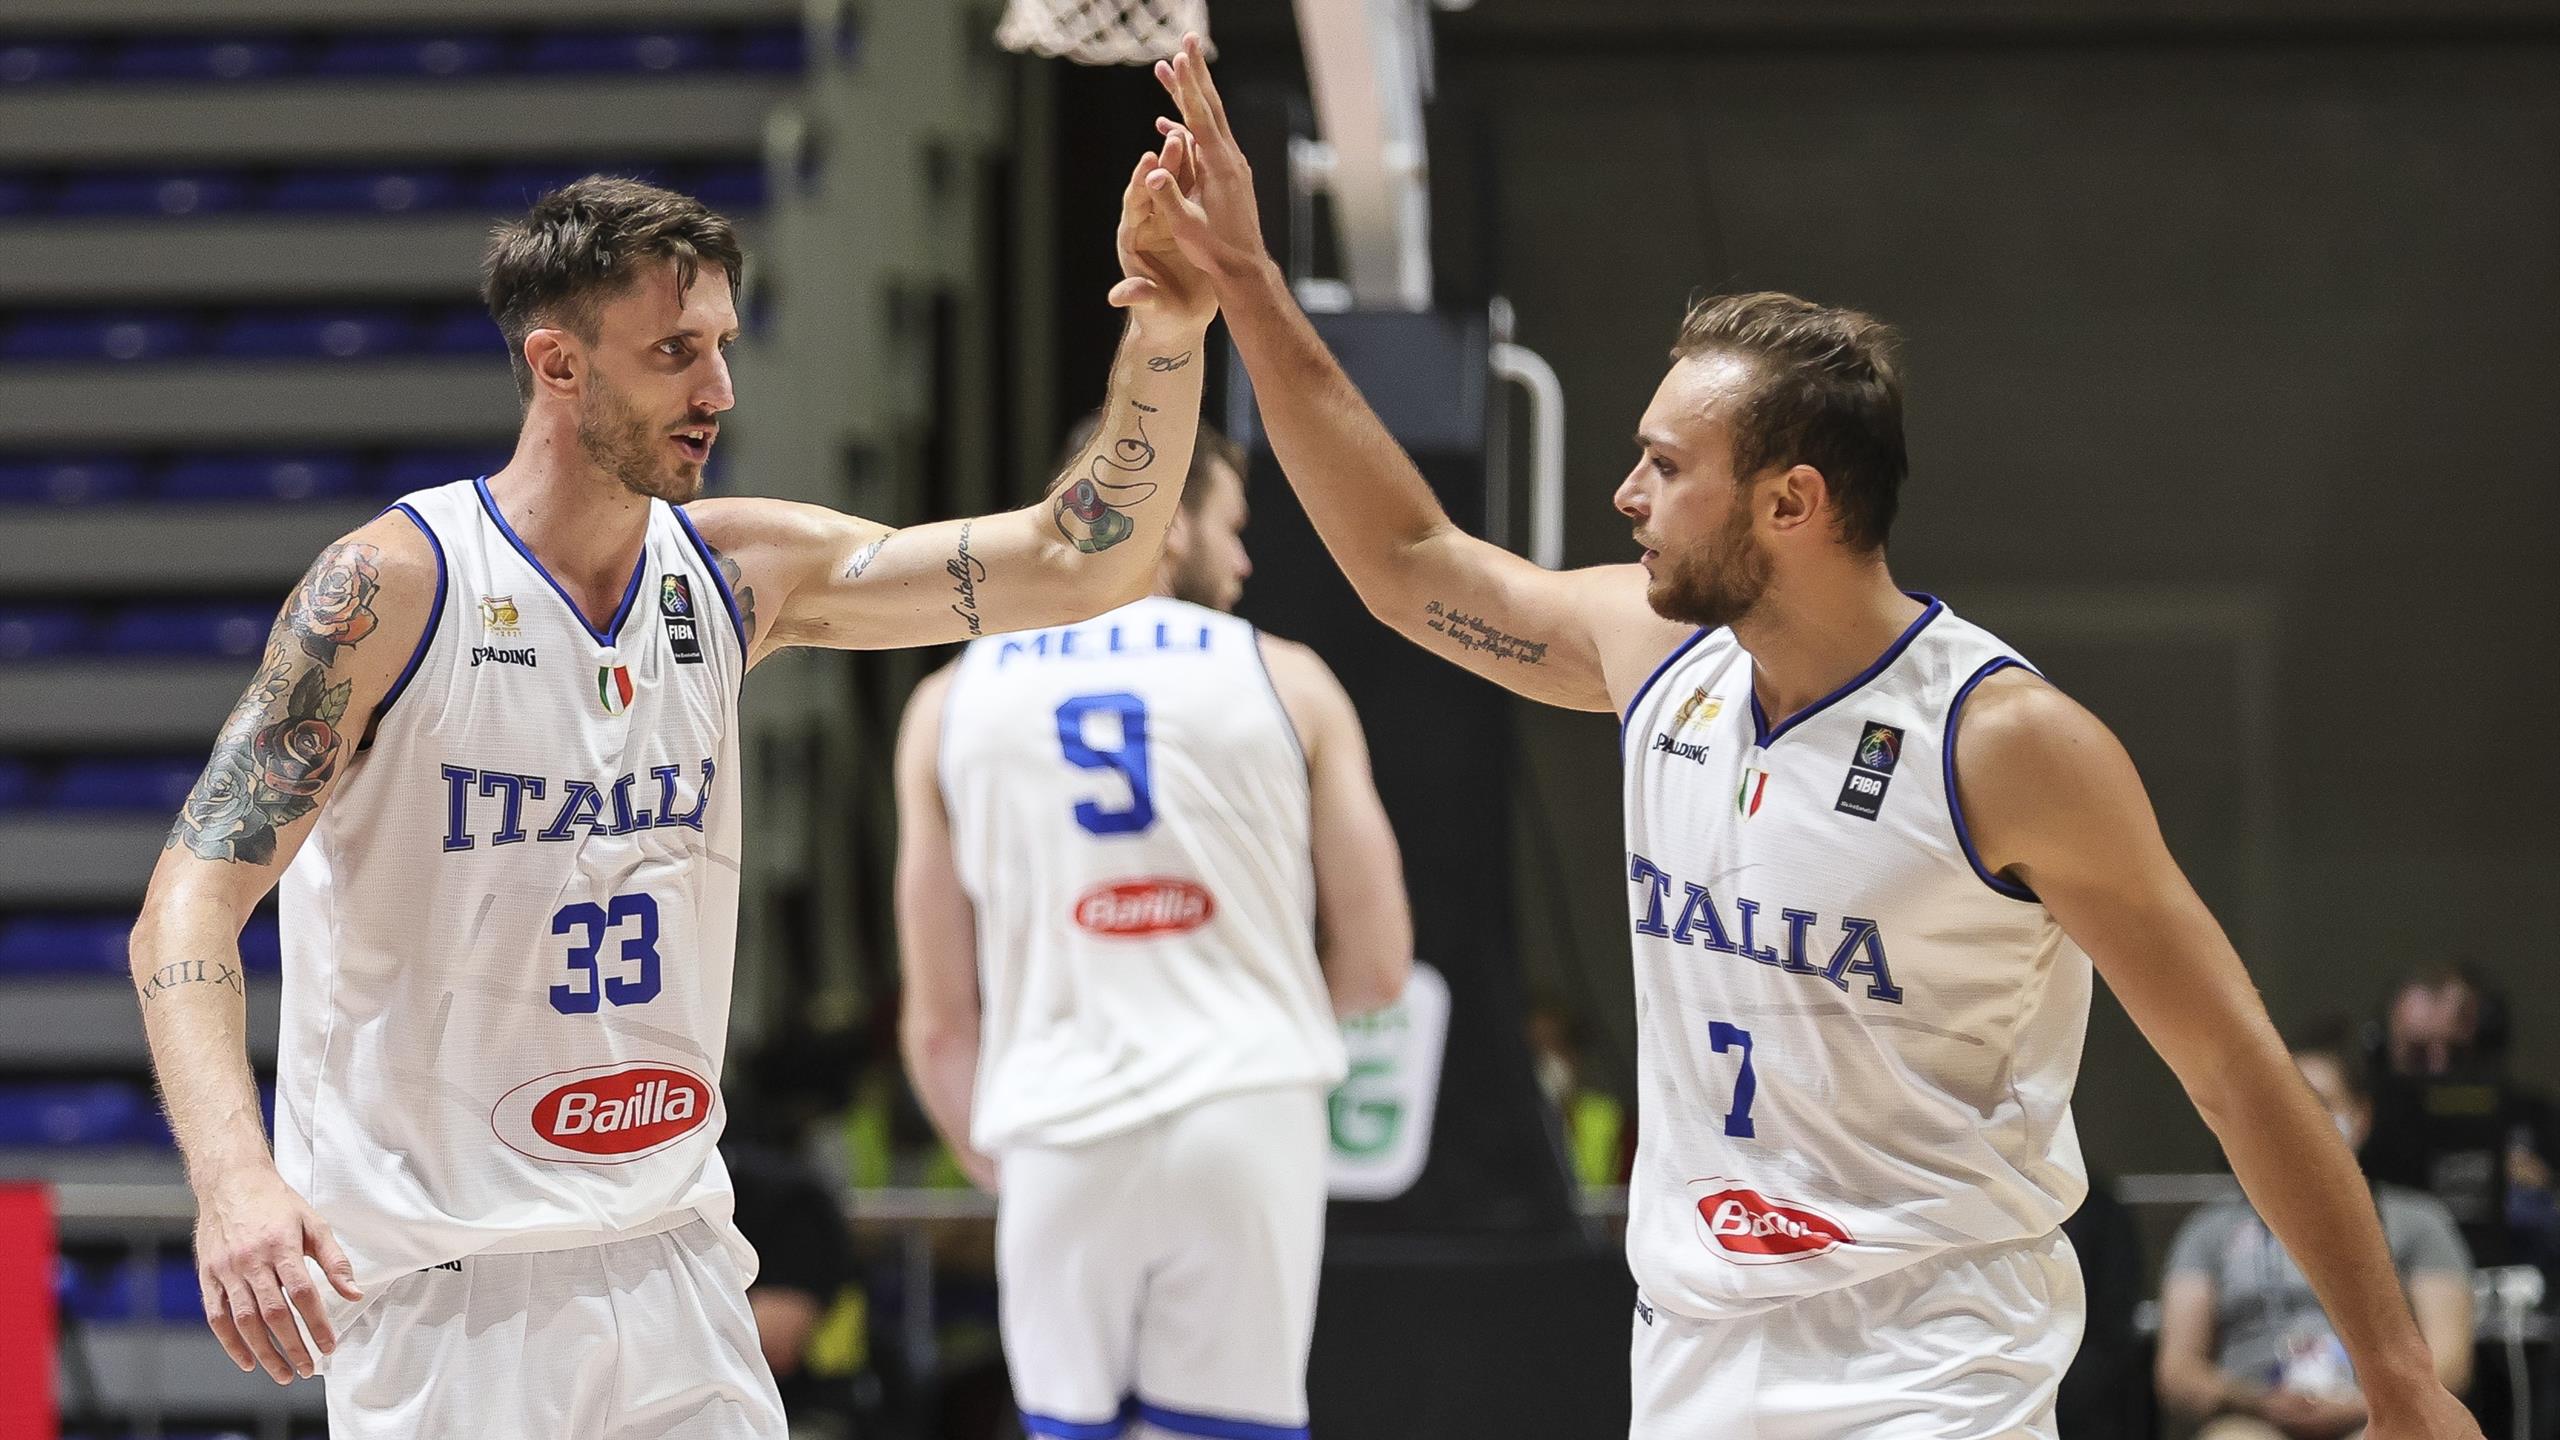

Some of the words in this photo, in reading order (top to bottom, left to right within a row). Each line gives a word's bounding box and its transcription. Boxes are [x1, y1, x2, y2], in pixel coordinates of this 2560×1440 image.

[668, 624, 695, 640] FIBA
[1056, 693, 1156, 834] 9
[1848, 774, 1882, 796] FIBA
[549, 892, 661, 1016] 33
[1627, 851, 1903, 1004] TALIA
[552, 1079, 696, 1136] Barilla
[1708, 1021, 1757, 1139] 7
